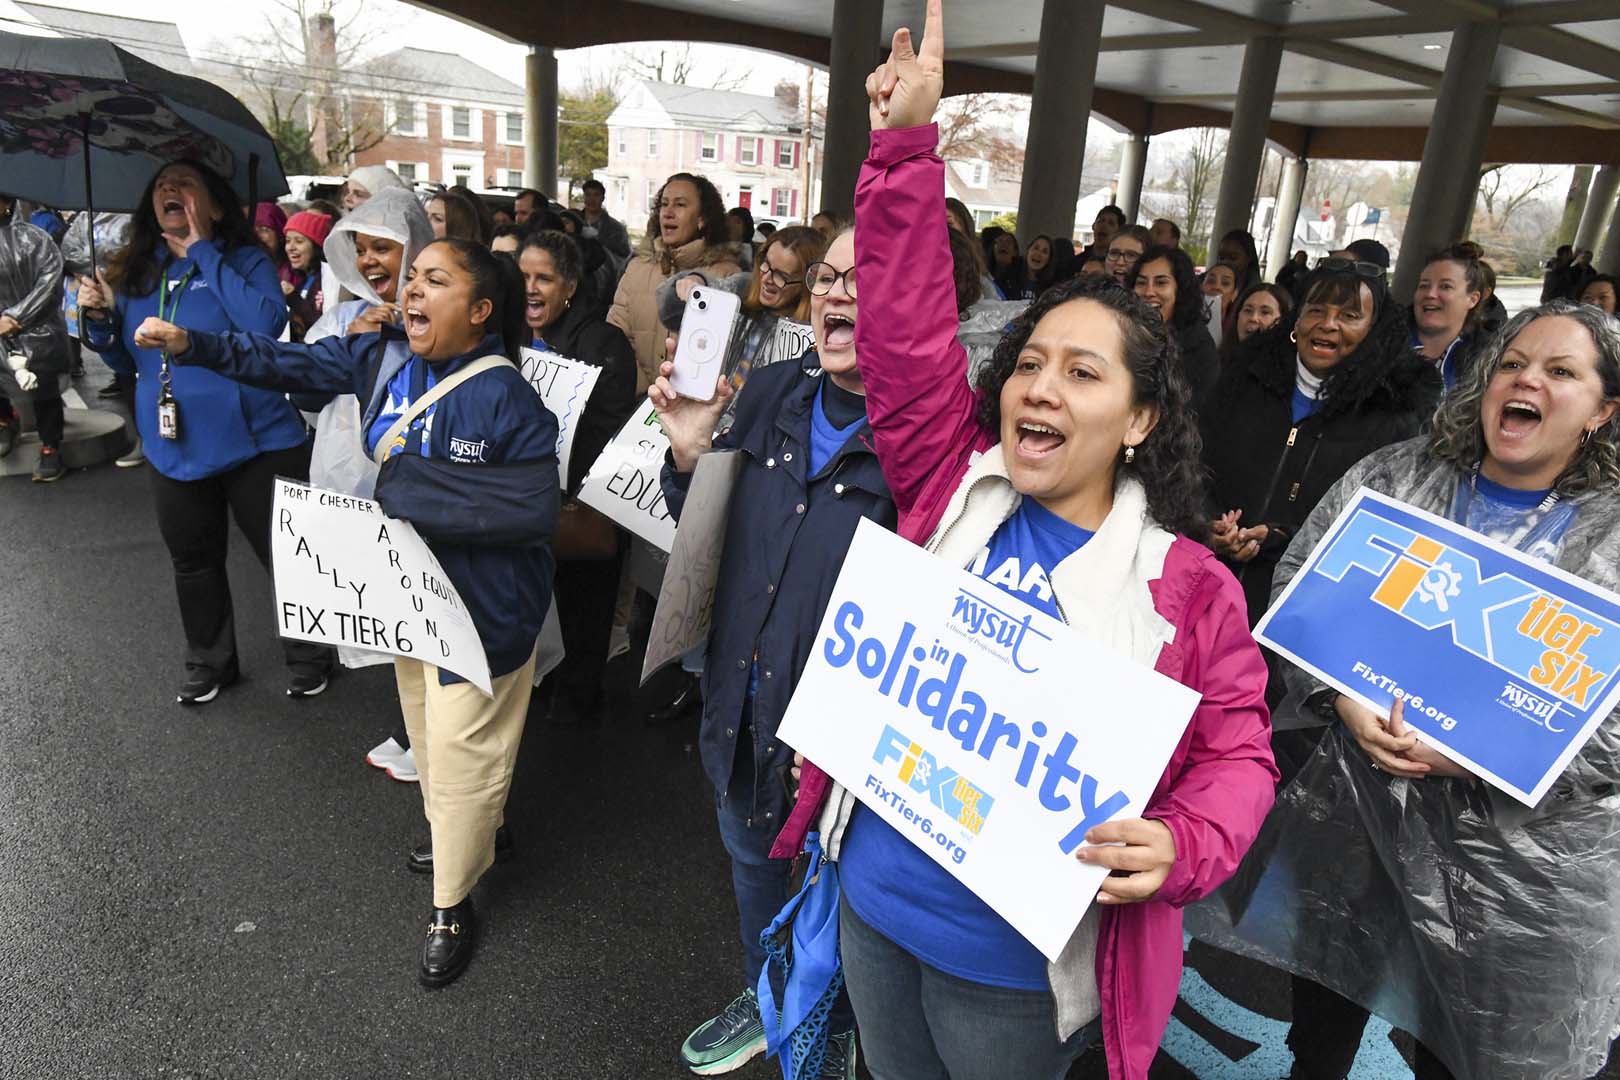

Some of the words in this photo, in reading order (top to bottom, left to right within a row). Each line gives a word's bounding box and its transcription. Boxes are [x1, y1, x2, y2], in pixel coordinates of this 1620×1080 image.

[449, 437, 489, 463] nysut
[283, 485, 312, 501] PORT
[319, 493, 374, 514] CHESTER
[283, 602, 326, 636] FIX
[334, 612, 390, 649] TIER
[395, 620, 414, 653] 6
[951, 587, 1053, 674] nysut
[1517, 593, 1602, 656] tier
[930, 638, 950, 666] in
[1529, 651, 1605, 706] six
[1352, 661, 1458, 732] FixTier6.org
[1501, 681, 1576, 733] nysut
[824, 600, 1131, 856] Solidarity
[952, 775, 983, 808] tier
[864, 773, 967, 865] FixTier6.org
